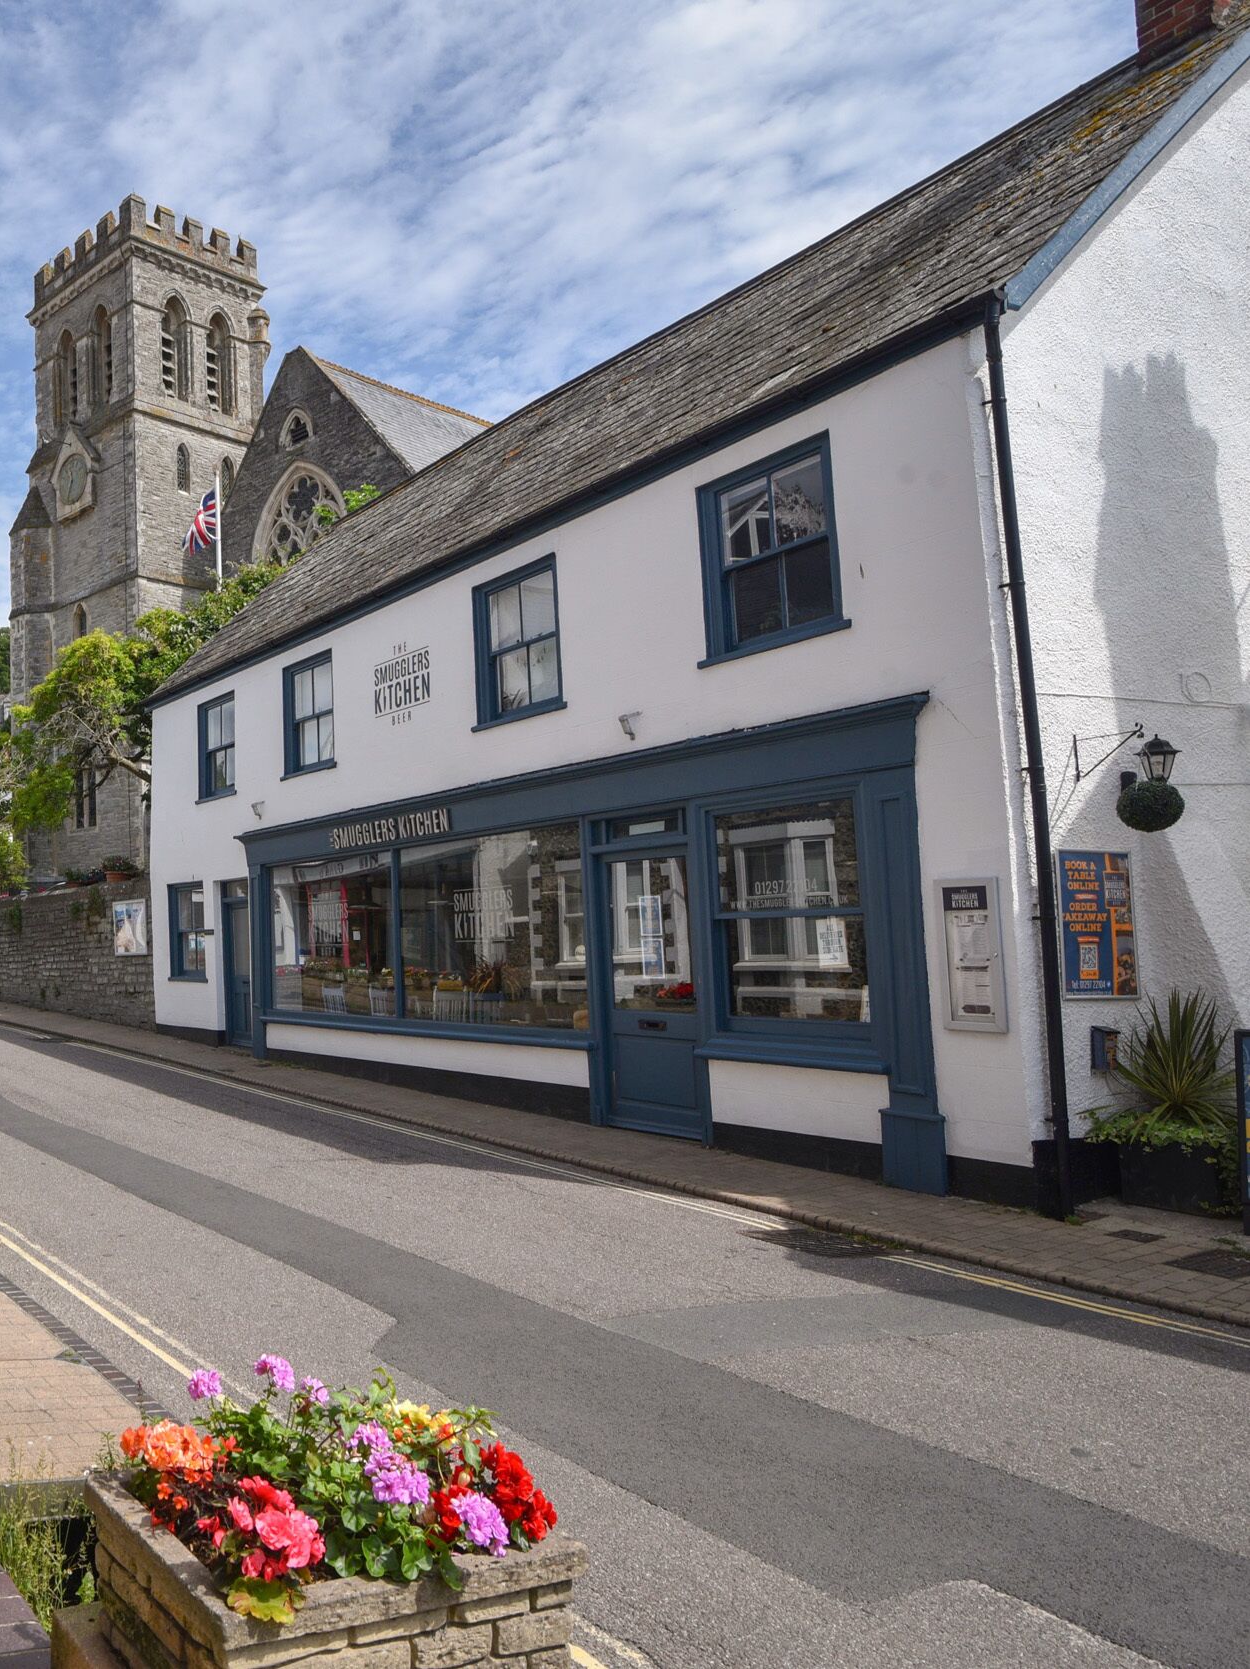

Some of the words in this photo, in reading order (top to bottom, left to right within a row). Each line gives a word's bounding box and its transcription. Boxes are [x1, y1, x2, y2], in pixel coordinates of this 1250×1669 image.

[393, 641, 407, 656] THE
[374, 649, 430, 687] SMUGGLERS
[374, 671, 431, 715] KITCHEN
[391, 710, 412, 726] BEER
[333, 818, 396, 849] SMUGGLERS
[398, 808, 449, 839] KITCHEN
[1064, 860, 1088, 870] BOOK
[1090, 861, 1097, 870] A
[1067, 871, 1096, 880] TABLE
[754, 880, 784, 895] 01297
[1067, 881, 1100, 890] ONLINE
[951, 899, 979, 909] KITCHEN
[1069, 902, 1098, 911] ORDER
[1070, 923, 1103, 932] ONLINE
